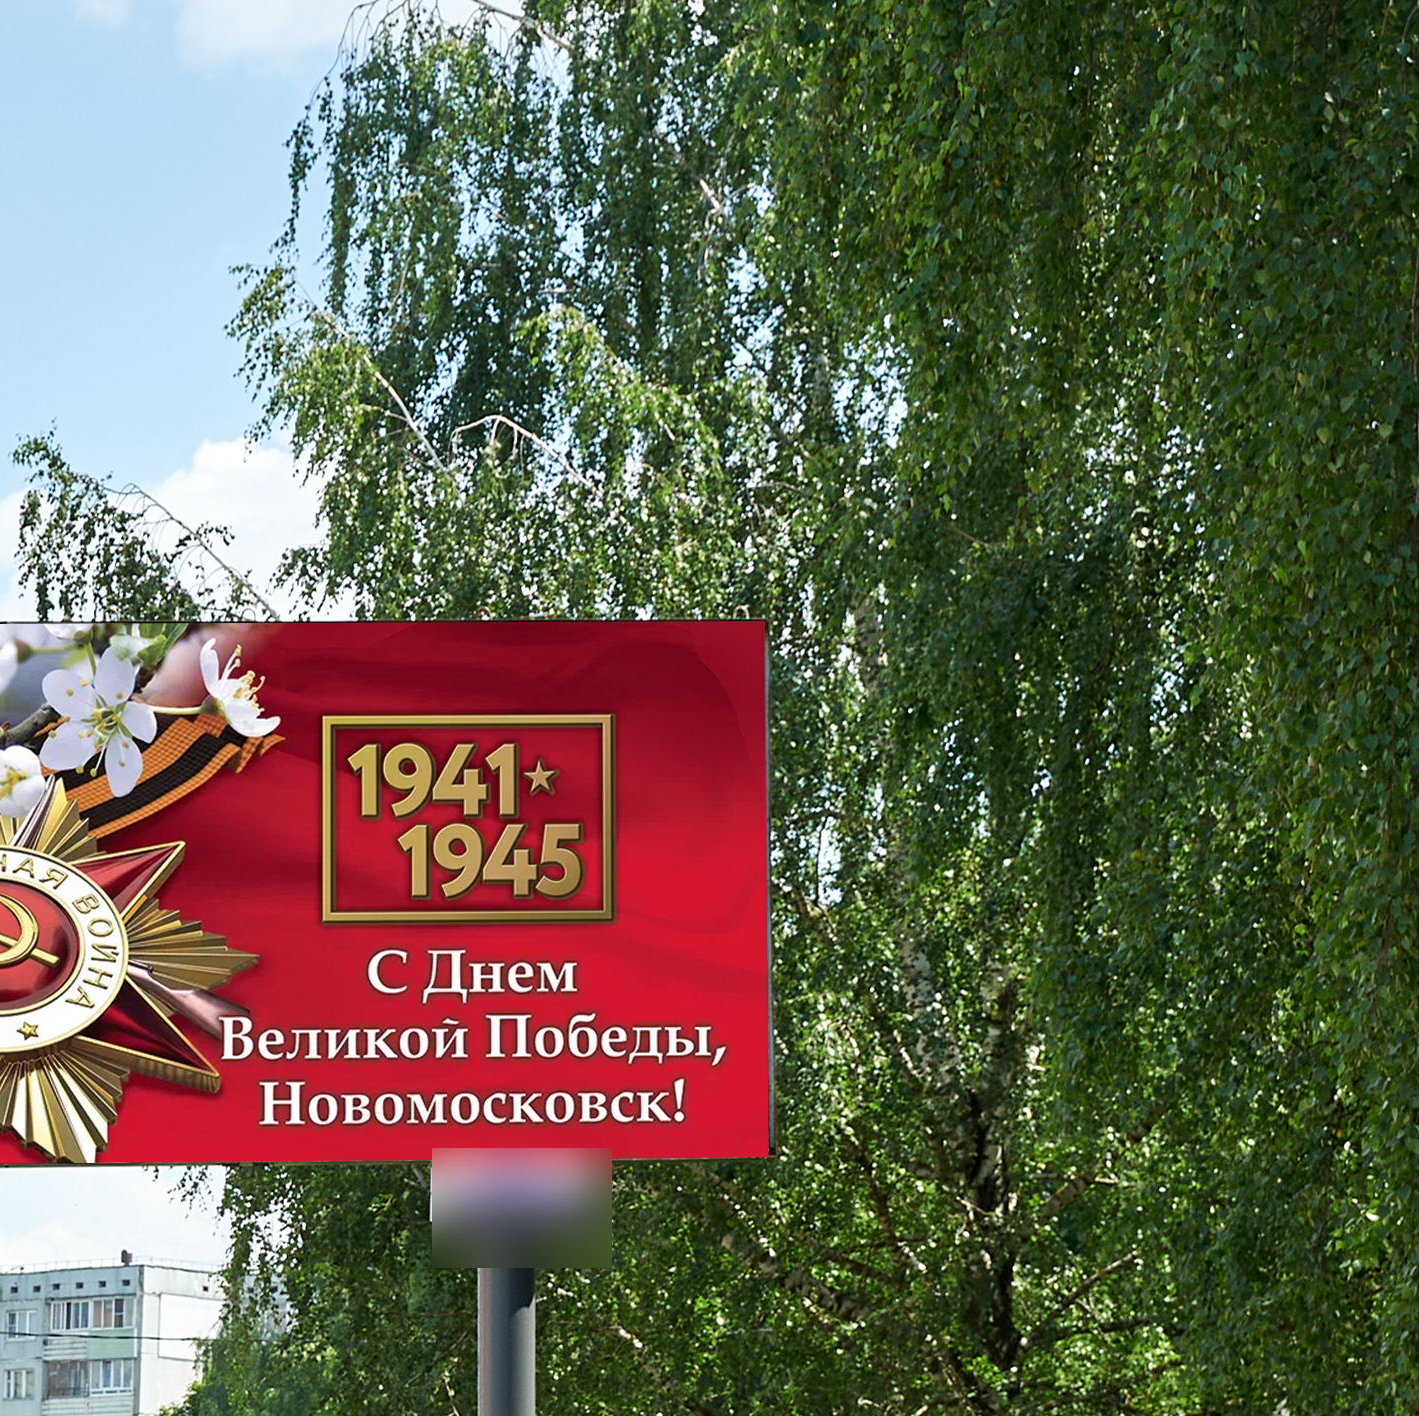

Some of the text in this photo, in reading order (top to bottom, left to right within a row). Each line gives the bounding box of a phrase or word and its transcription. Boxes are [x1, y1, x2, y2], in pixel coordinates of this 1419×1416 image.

[347, 743, 521, 818] 1941
[398, 823, 584, 899] 1945
[65, 893, 120, 1010] ВОЙНА
[366, 949, 578, 1004] С Днем
[218, 1012, 728, 1067] Великой Победы,
[258, 1077, 687, 1126] Новомосковск!
